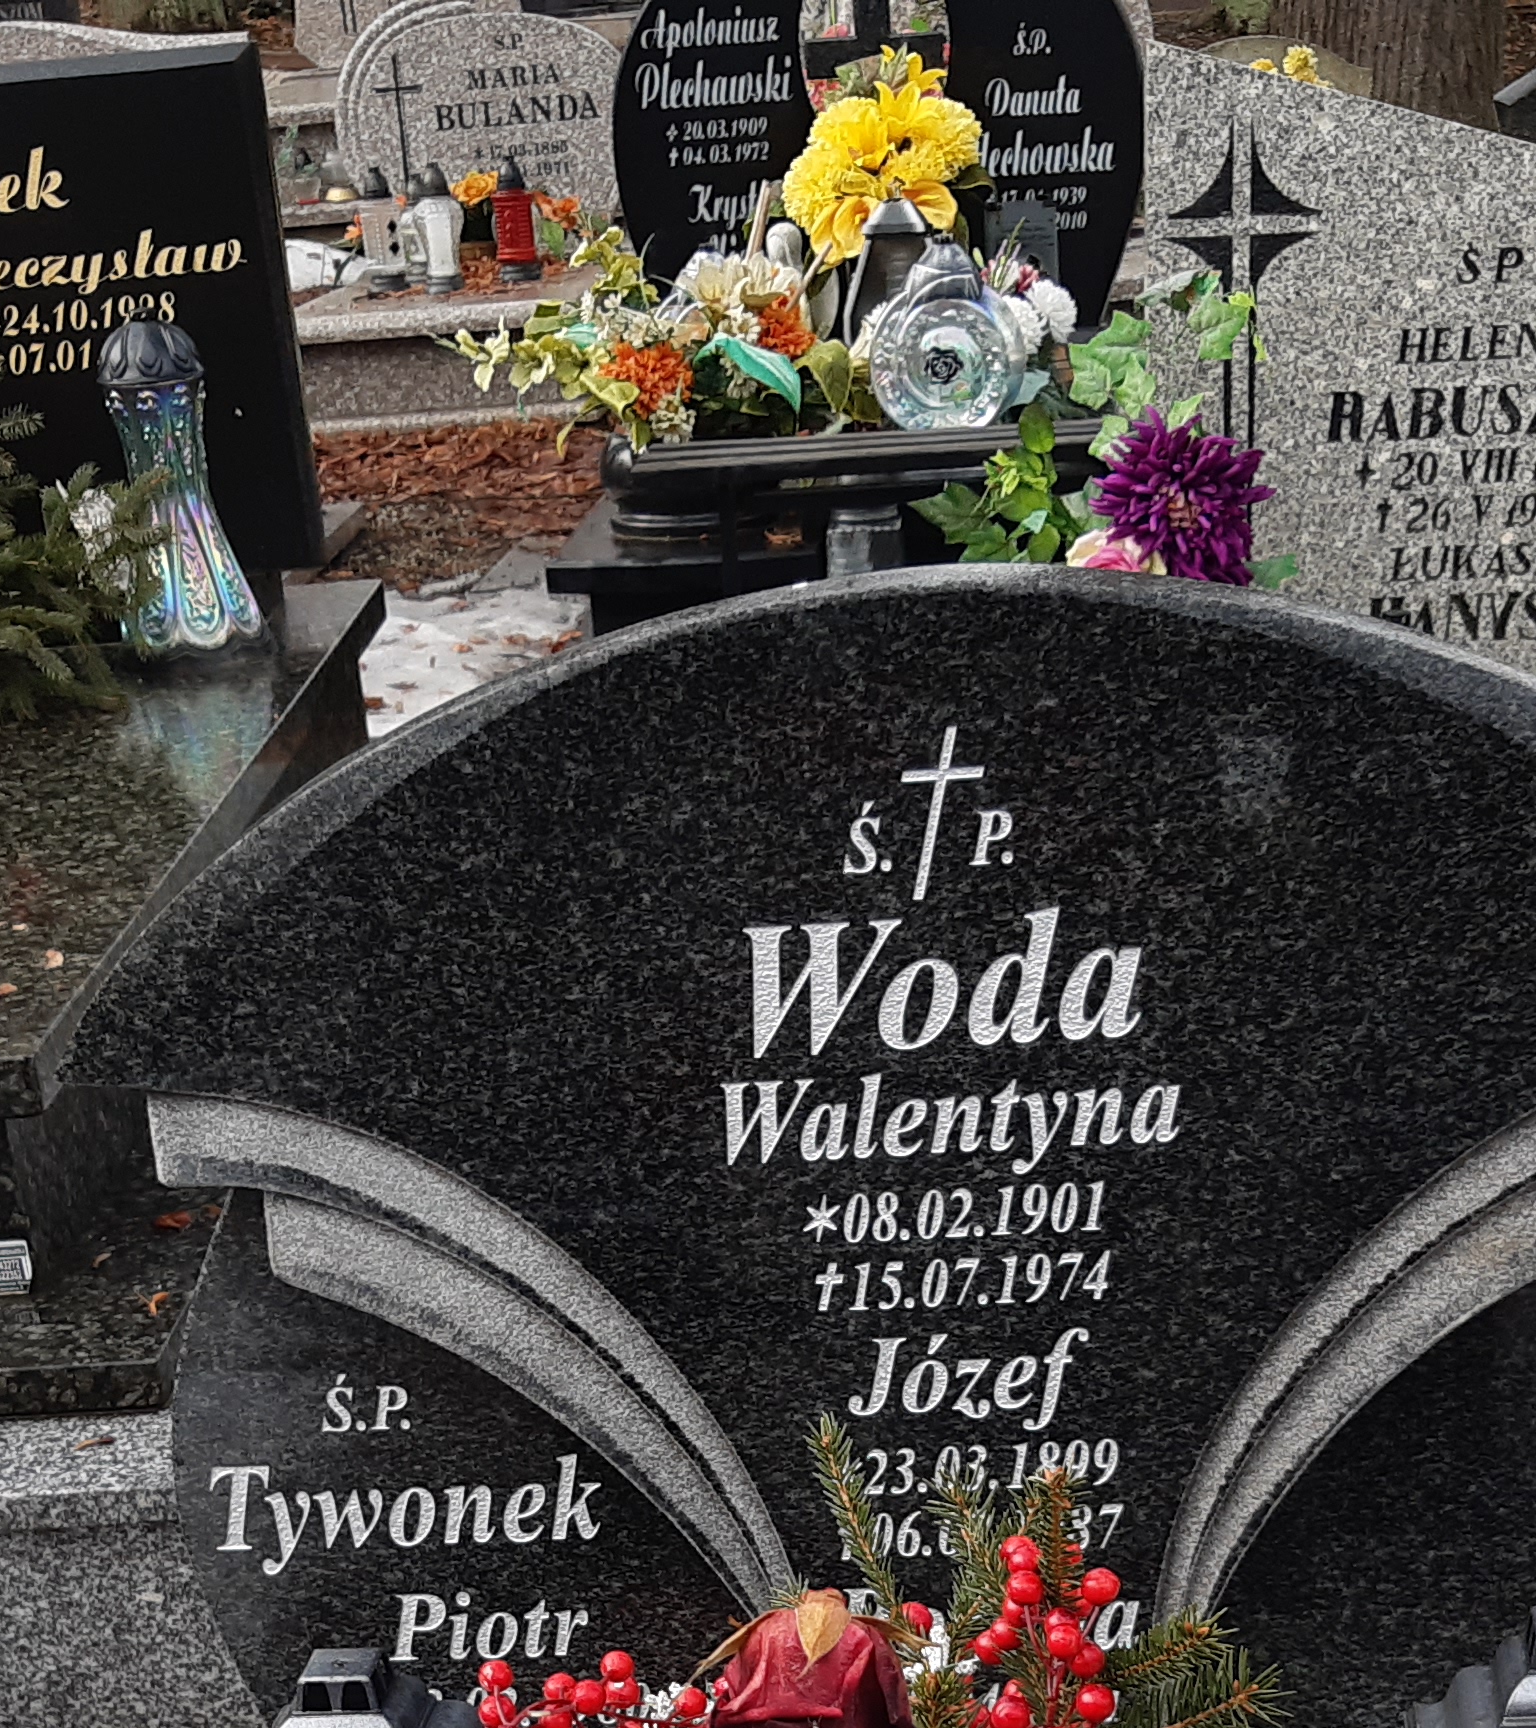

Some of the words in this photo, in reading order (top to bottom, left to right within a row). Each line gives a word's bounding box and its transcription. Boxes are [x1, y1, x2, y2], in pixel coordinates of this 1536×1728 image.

[640, 5, 780, 58] Apoloniusz
[466, 63, 561, 91] MARIA
[985, 74, 1082, 117] Danuta
[434, 90, 602, 132] BULANDA
[682, 116, 768, 142] 20.03.1909
[682, 141, 770, 165] 04.03.1972
[979, 125, 1116, 178] lechowska
[688, 180, 760, 231] Kryst
[1390, 451, 1439, 491] 20
[1460, 447, 1518, 485] VIII
[742, 905, 1143, 1060] Woda
[719, 1073, 1182, 1175] Walentyna
[843, 1181, 1105, 1244] 08.02.1901
[853, 1250, 1111, 1310] 15.07.1974
[321, 1374, 413, 1433] Ś.P.
[847, 1327, 1089, 1431] Józef
[209, 1453, 602, 1575] Tywonek
[389, 1591, 589, 1663] Piotr
